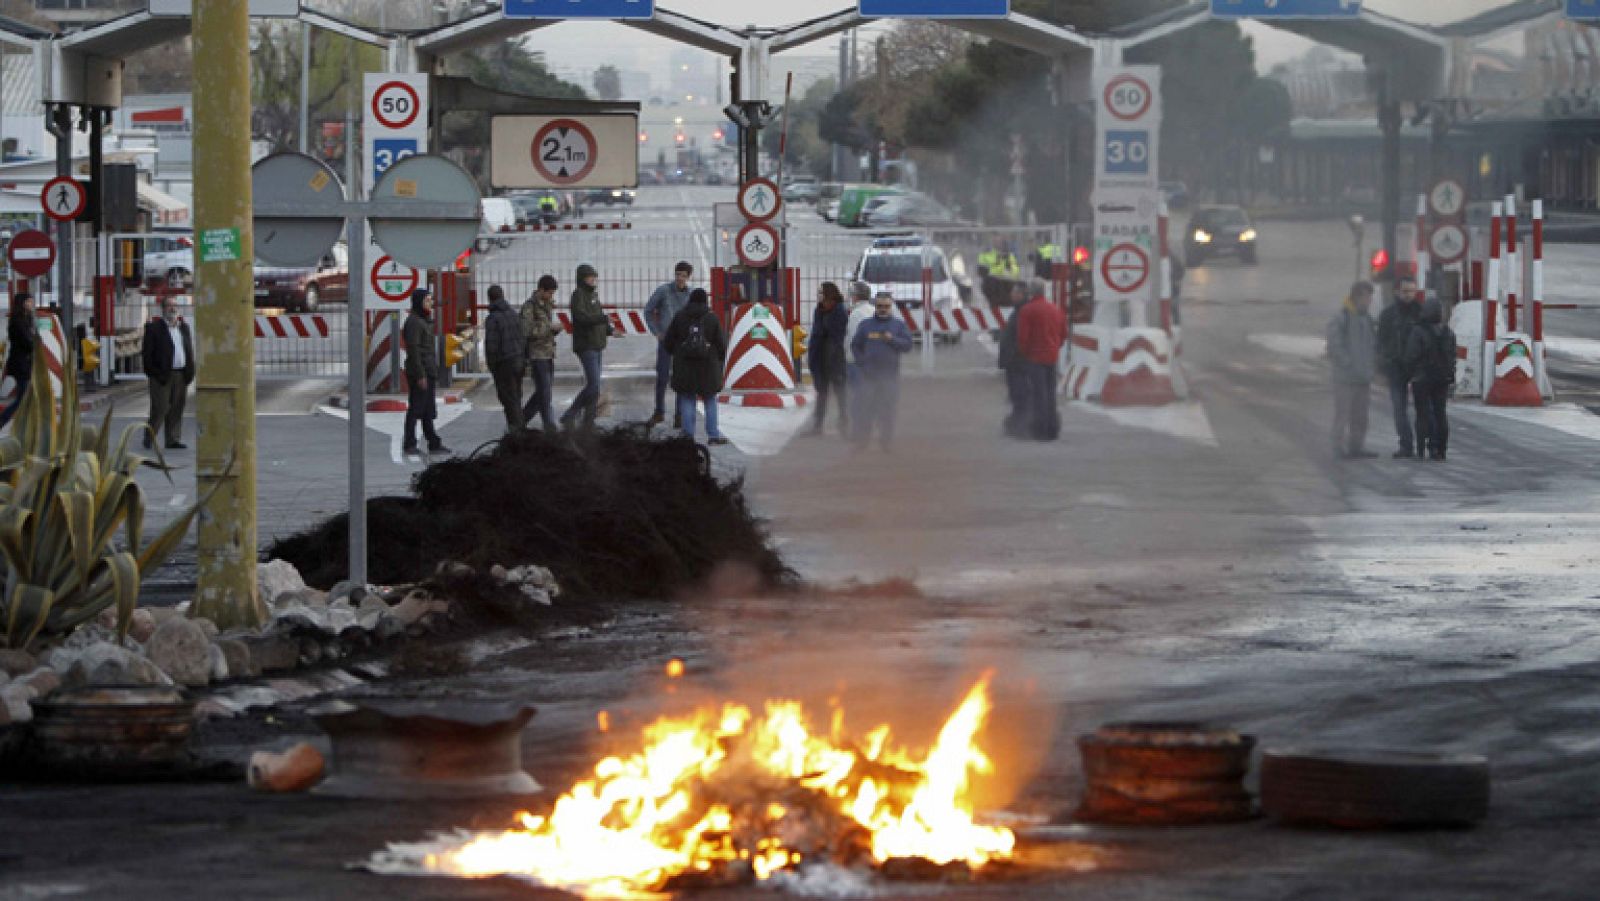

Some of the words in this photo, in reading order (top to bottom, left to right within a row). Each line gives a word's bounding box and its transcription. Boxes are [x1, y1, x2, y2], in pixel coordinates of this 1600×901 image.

[382, 97, 409, 113] 50
[1114, 89, 1141, 105] 50
[543, 137, 586, 163] 2,1m
[1107, 140, 1146, 164] 30
[1100, 224, 1150, 236] RADAR
